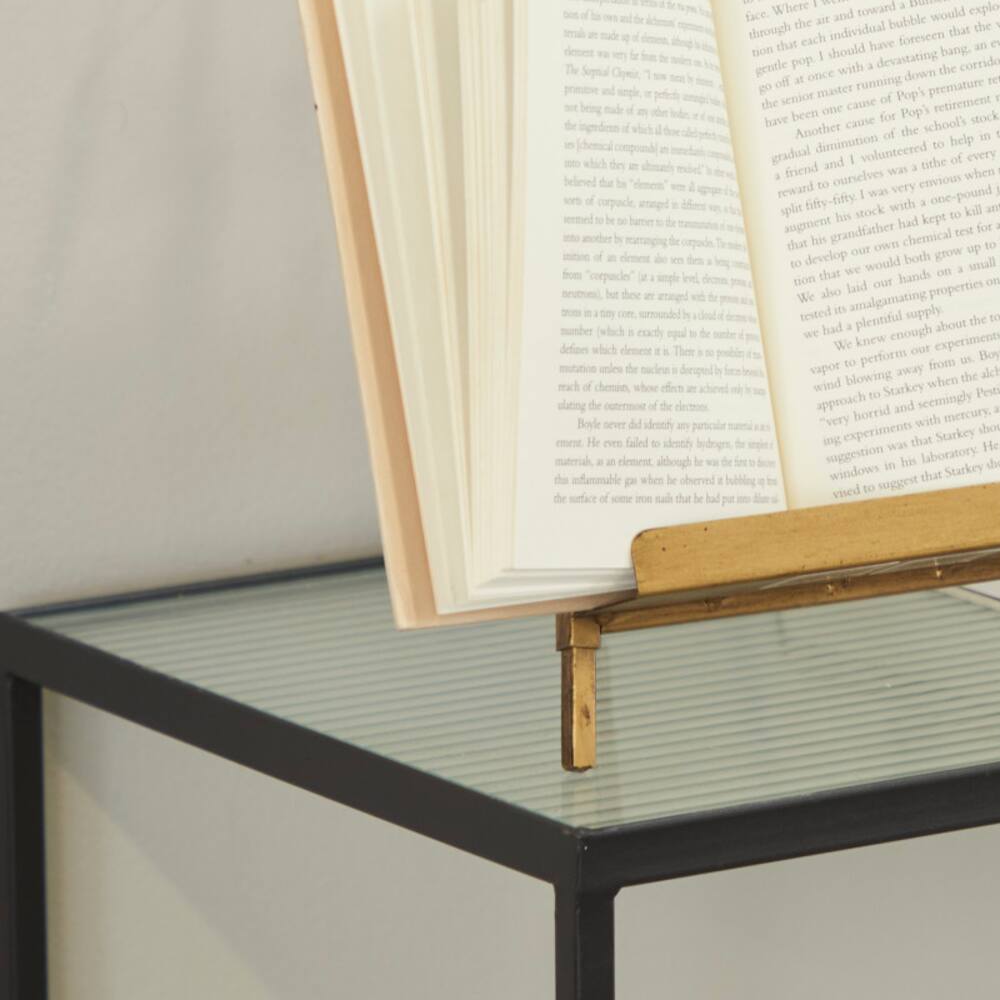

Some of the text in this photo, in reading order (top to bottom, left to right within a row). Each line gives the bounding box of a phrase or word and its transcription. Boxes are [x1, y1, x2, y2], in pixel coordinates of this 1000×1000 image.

[749, 21, 791, 40] through
[857, 0, 896, 17] toward
[771, 2, 809, 15] Where
[830, 20, 885, 40] individual
[888, 13, 926, 29] bubble
[755, 58, 787, 78] gentle
[828, 42, 866, 59] should
[899, 31, 945, 46] foreseen
[807, 70, 834, 81] once
[876, 50, 938, 68] devastating
[817, 84, 852, 98] master
[856, 75, 902, 91] running
[764, 116, 788, 127] have
[846, 98, 876, 110] cause
[928, 79, 984, 98] premature
[795, 122, 840, 139] Another
[845, 117, 875, 129] cause
[934, 95, 991, 112] retirement
[771, 144, 811, 166] gradual
[970, 109, 999, 124] stock
[785, 161, 818, 178] friend
[860, 140, 927, 162] volunteered
[949, 133, 974, 147] help
[777, 180, 814, 198] reward
[832, 170, 884, 186] ourselves
[919, 175, 961, 189] envious
[784, 216, 831, 234] augment
[830, 222, 894, 245] grandfather
[964, 203, 982, 216] kill
[804, 249, 848, 266] develop
[902, 227, 952, 246] chemical
[865, 255, 901, 272] would
[903, 250, 931, 264] both
[898, 268, 931, 284] hands
[969, 255, 996, 271] small
[800, 279, 983, 321] tested amalgamating properties
[855, 309, 902, 332] plentiful
[890, 323, 932, 340] enough
[935, 319, 966, 332] about
[810, 332, 1000, 376] vapor perform experiments
[845, 370, 893, 386] blowing
[928, 359, 956, 370] from
[817, 391, 866, 413] approach
[882, 382, 924, 397] Starkey
[918, 389, 972, 409] seemingly
[826, 446, 884, 464] suggestion
[935, 427, 974, 442] Starkey
[843, 422, 912, 442] experiments
[830, 465, 879, 480] windows
[878, 474, 918, 491] suggest
[944, 463, 983, 478] Starkey
